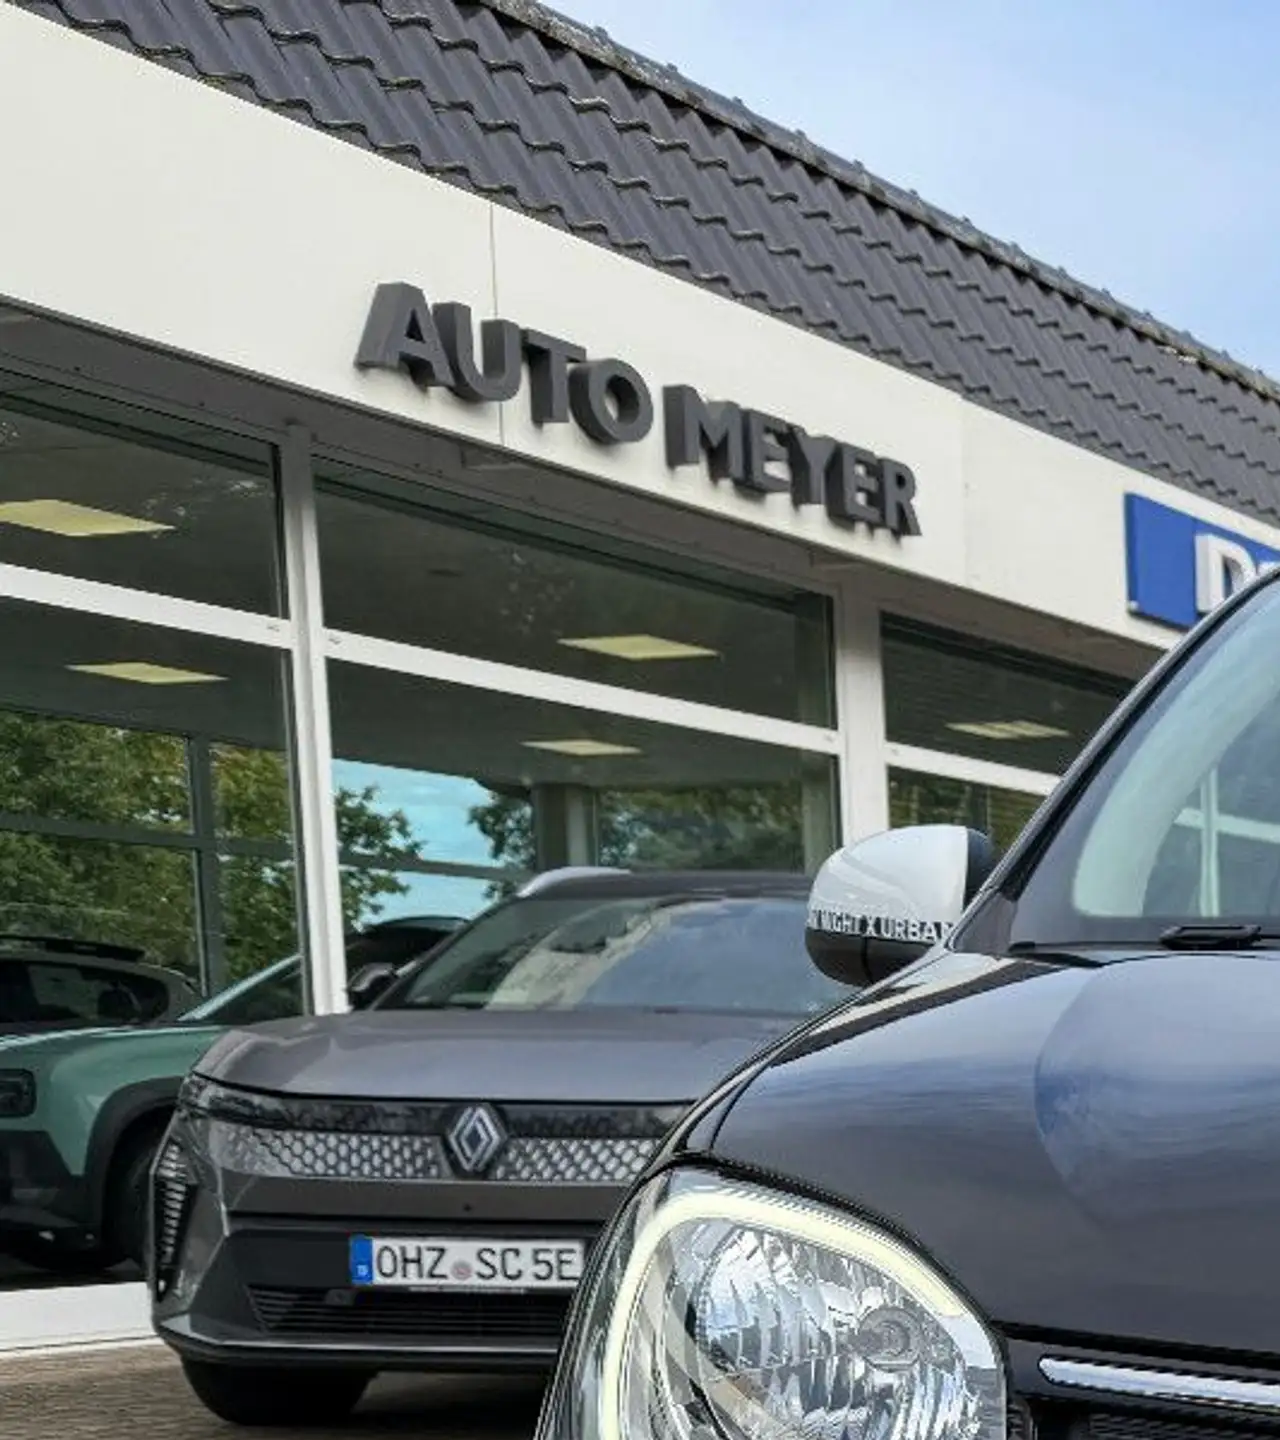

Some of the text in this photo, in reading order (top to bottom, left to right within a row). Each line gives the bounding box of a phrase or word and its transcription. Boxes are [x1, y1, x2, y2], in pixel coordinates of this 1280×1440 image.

[354, 280, 922, 538] AUTO MEYER
[376, 1245, 448, 1279] OHZ
